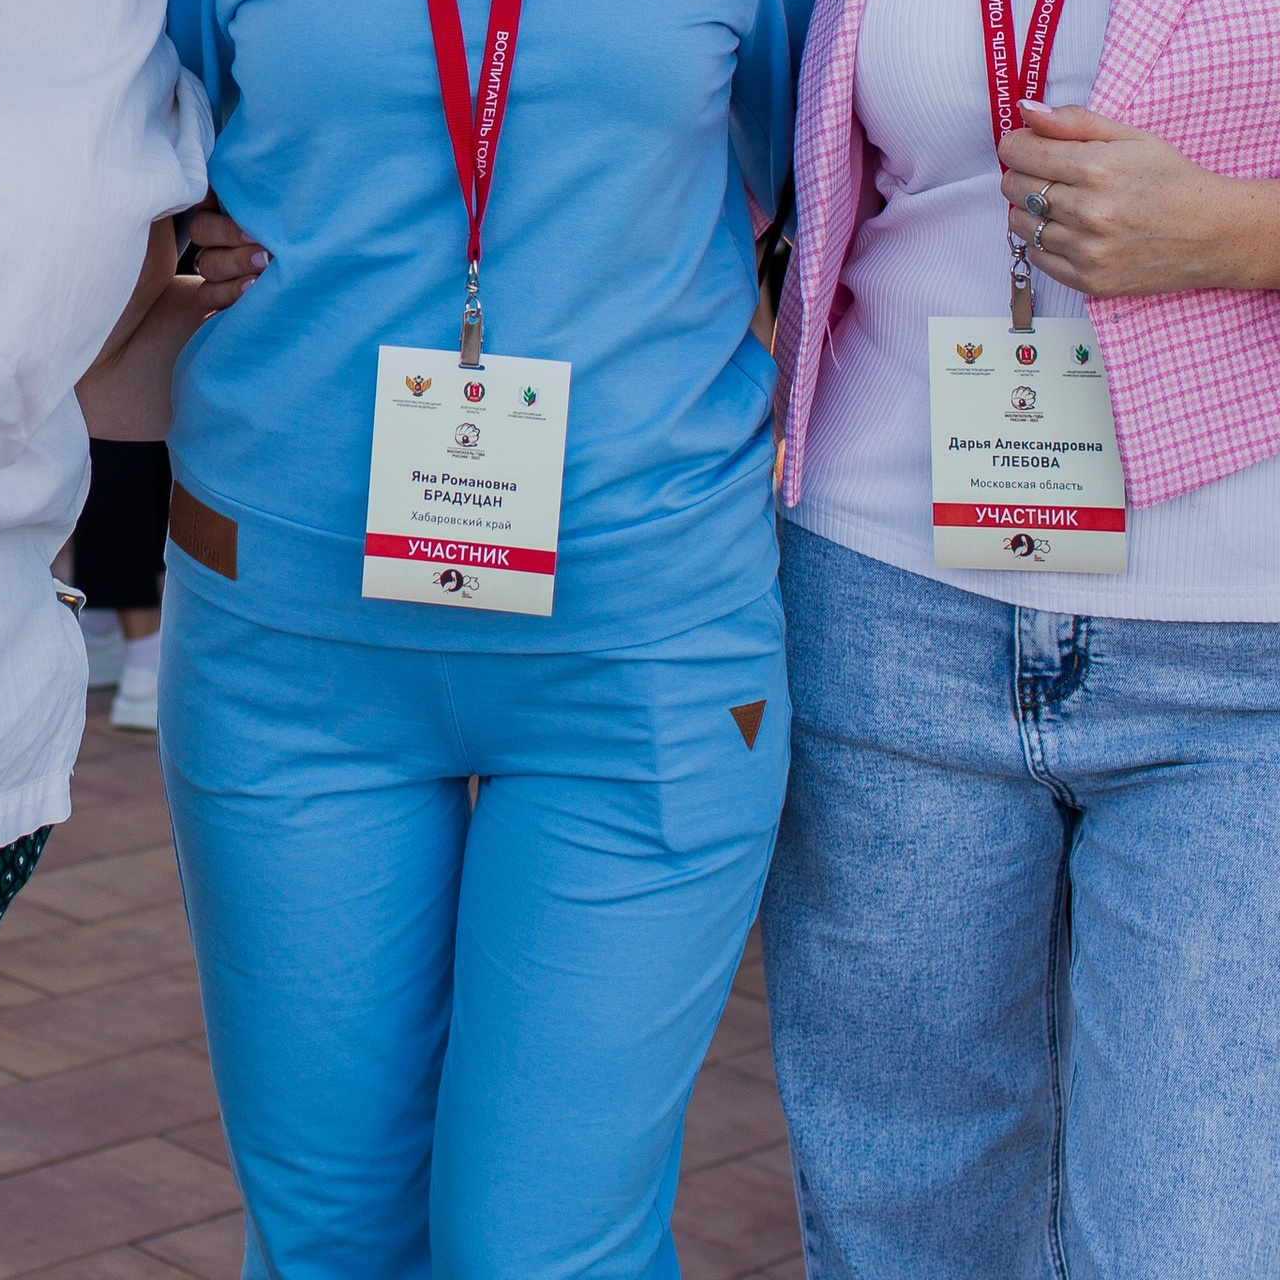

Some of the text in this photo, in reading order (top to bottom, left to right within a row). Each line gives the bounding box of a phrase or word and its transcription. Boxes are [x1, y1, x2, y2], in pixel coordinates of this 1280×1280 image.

[992, 31, 1012, 139] ВОСПИТАТЕЛЬ
[477, 30, 509, 179] ВОСПИТАТЕЛЬ ГОДА
[948, 437, 1103, 453] Дарья Александровна
[992, 455, 1060, 468] ГЛЕБОВА
[411, 471, 517, 492] Яна Романовна
[970, 478, 1083, 491] Московская область
[423, 489, 503, 508] БРАДУЦАН
[411, 511, 512, 531] Хабаровский край
[975, 507, 1078, 526] УЧАСТНИК
[408, 539, 510, 566] УЧАСТНИК
